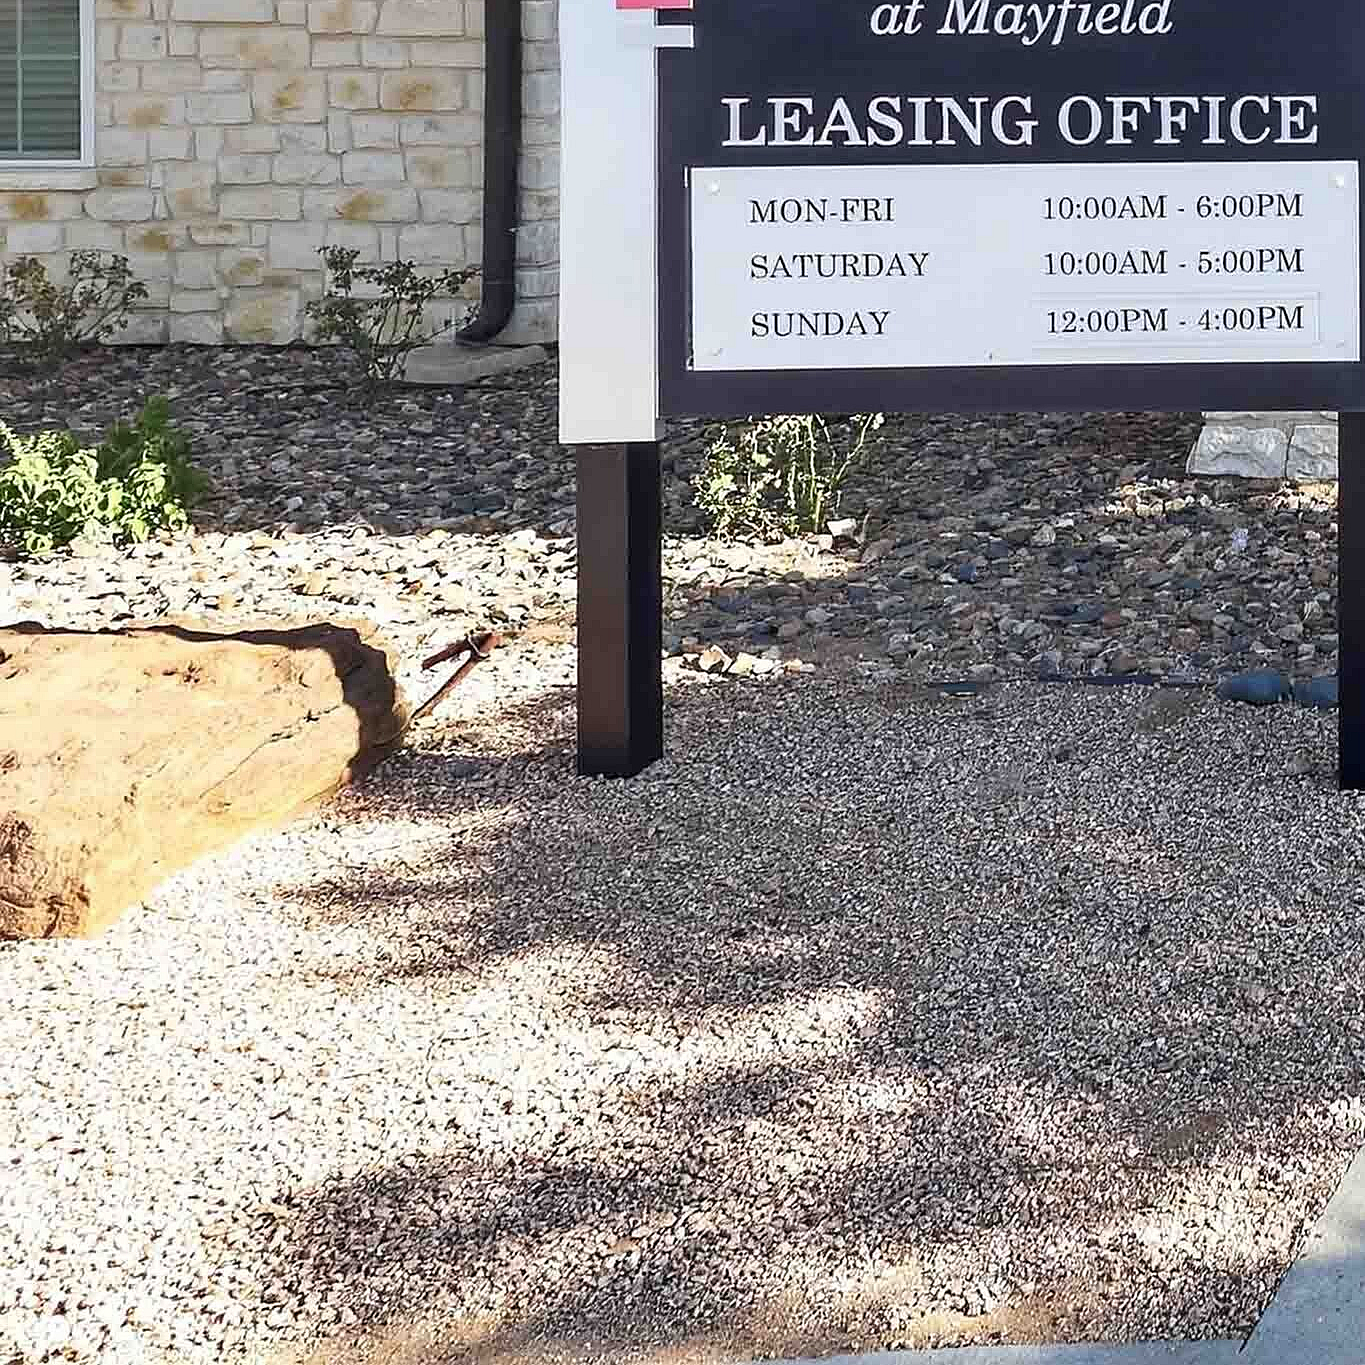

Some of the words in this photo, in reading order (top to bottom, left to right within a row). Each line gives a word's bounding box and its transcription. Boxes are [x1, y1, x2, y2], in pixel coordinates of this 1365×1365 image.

[720, 95, 1039, 147] LEASING
[1058, 95, 1318, 145] OFFICE
[749, 197, 895, 224] MON-FRI
[1043, 194, 1169, 220] 10:00AM
[1196, 193, 1304, 219] 6:00PM
[750, 252, 929, 279] SATURDAY
[1044, 249, 1169, 276] 10:00AM
[1197, 248, 1305, 275] 5:00PM
[751, 310, 891, 338] SUNDAY
[1047, 307, 1169, 334] 12:00PM
[1197, 305, 1305, 331] 4:00PM
